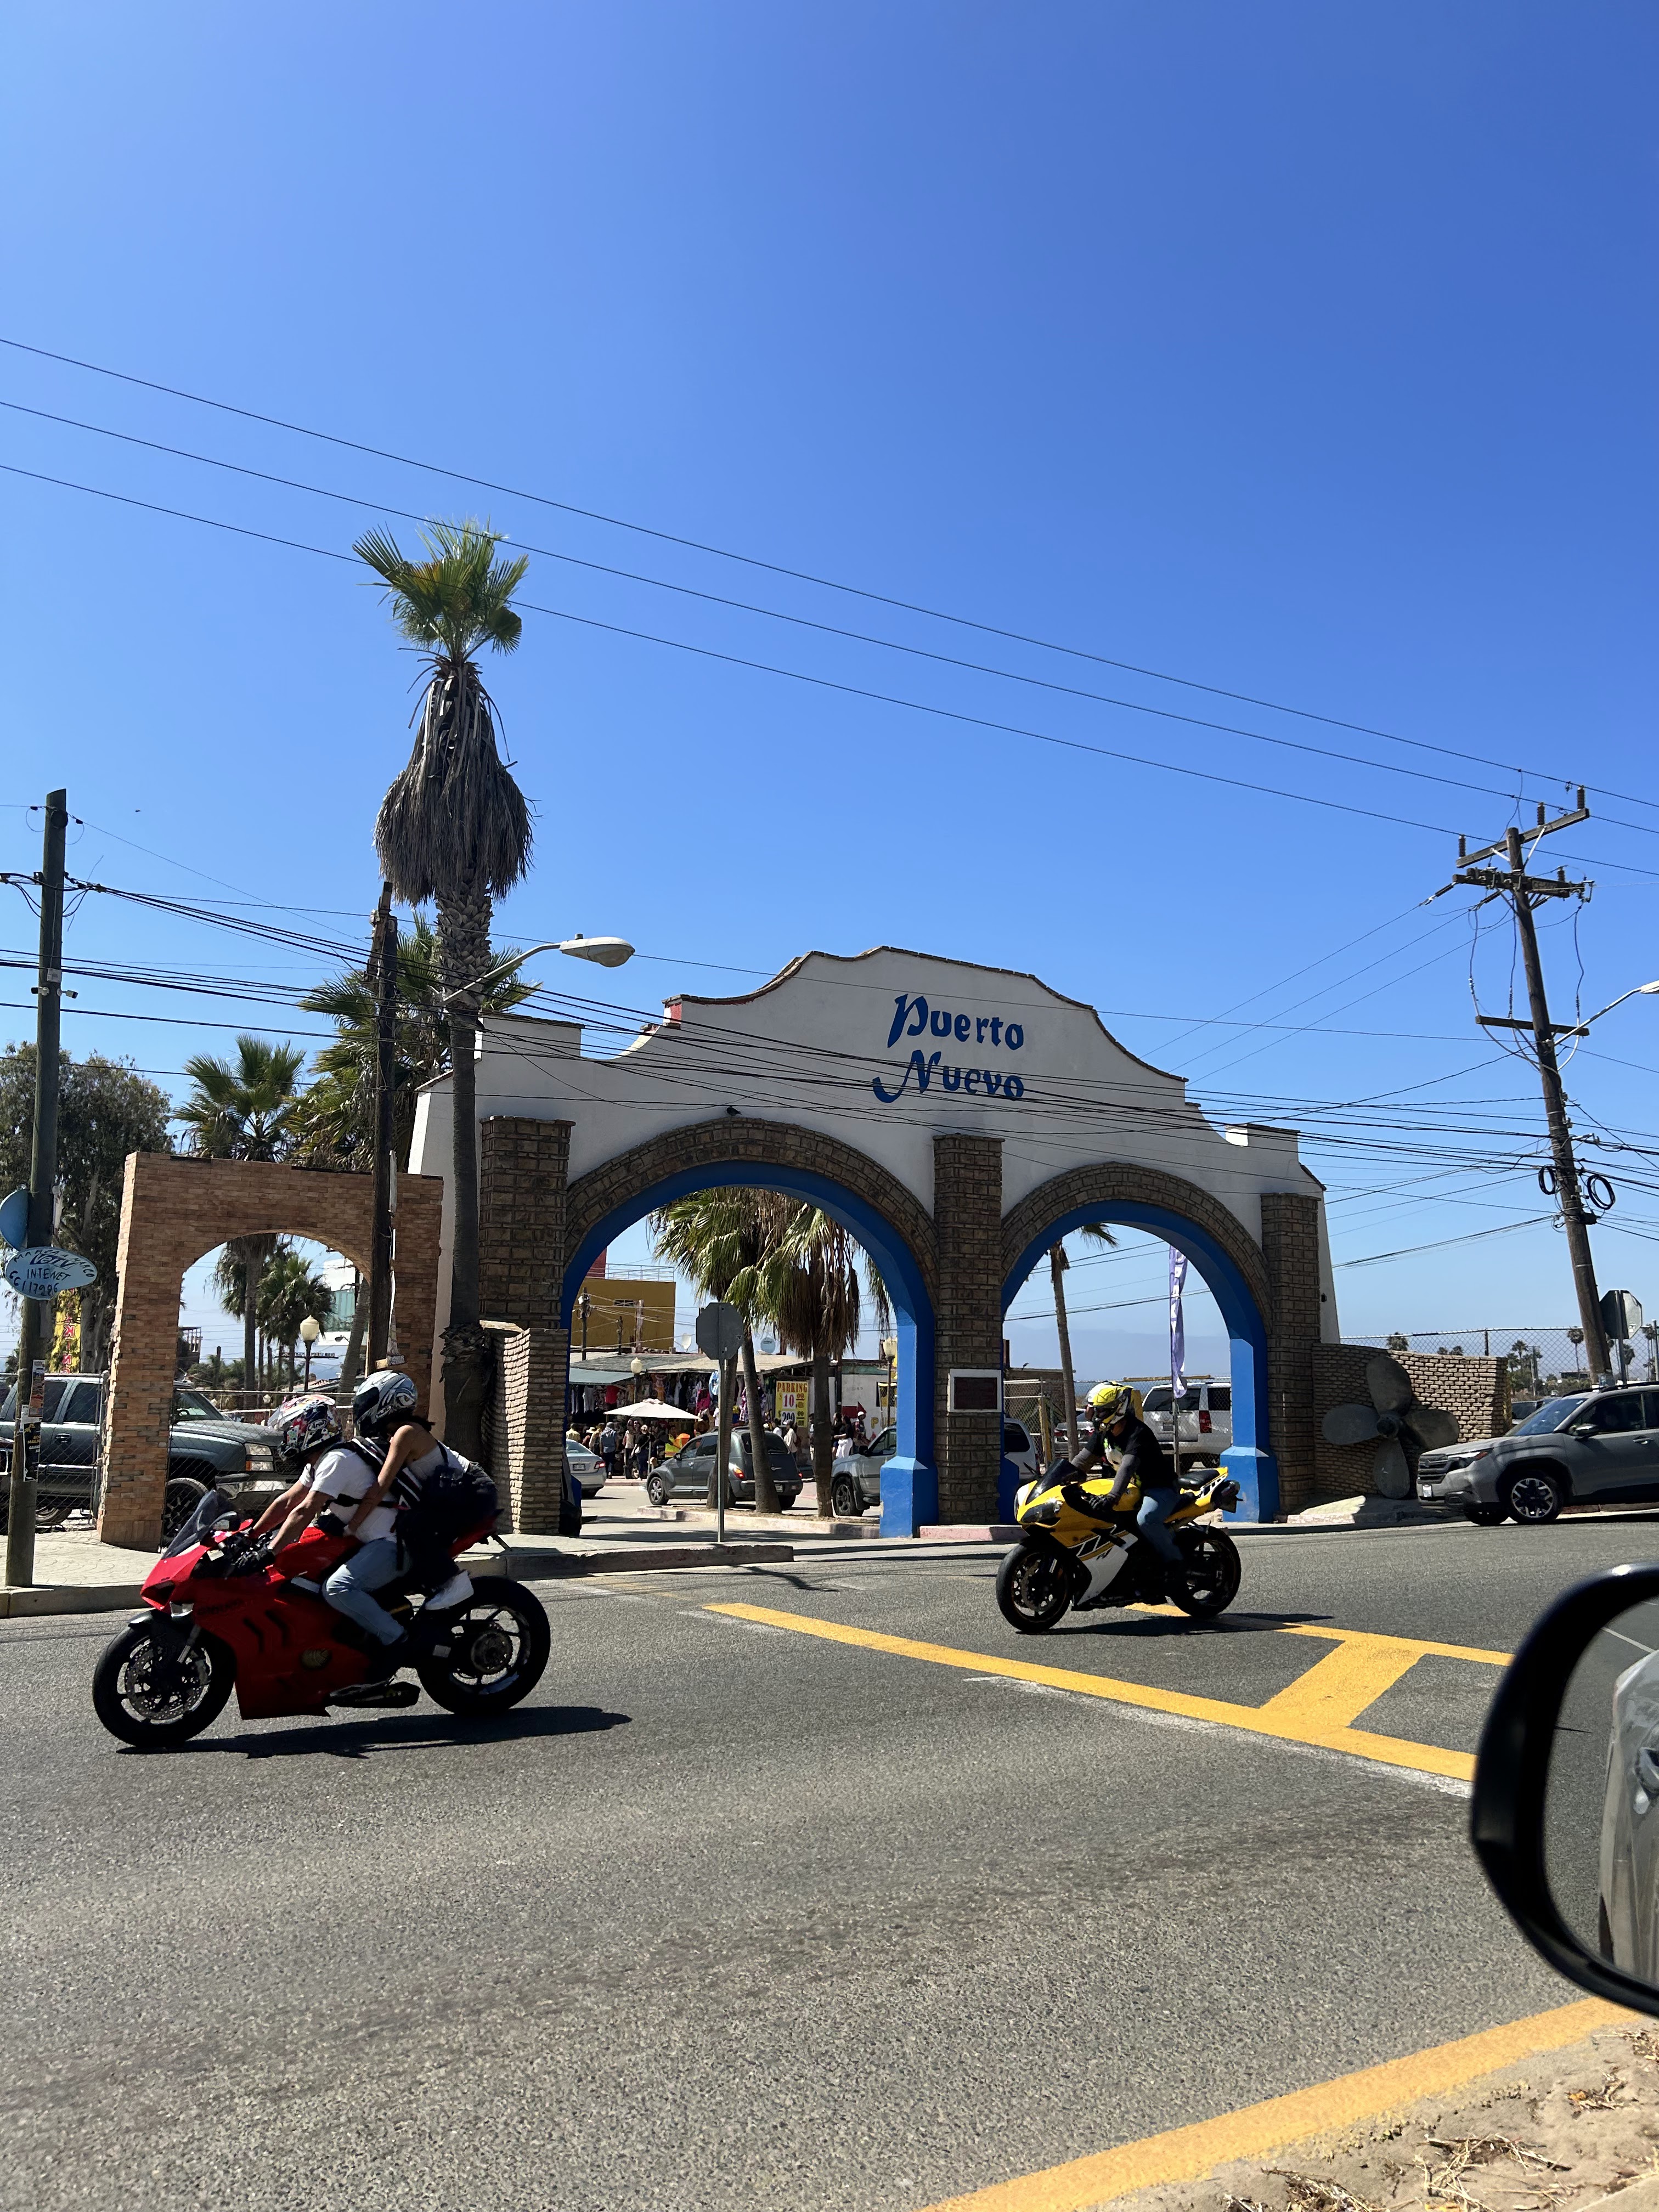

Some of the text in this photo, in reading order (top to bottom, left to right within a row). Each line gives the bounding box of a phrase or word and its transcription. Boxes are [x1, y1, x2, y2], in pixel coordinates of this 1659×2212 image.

[887, 993, 1024, 1051] Puerto
[872, 1049, 1024, 1103] Nuevo
[27, 1267, 71, 1281] INTENET
[777, 1382, 808, 1392] PARKING
